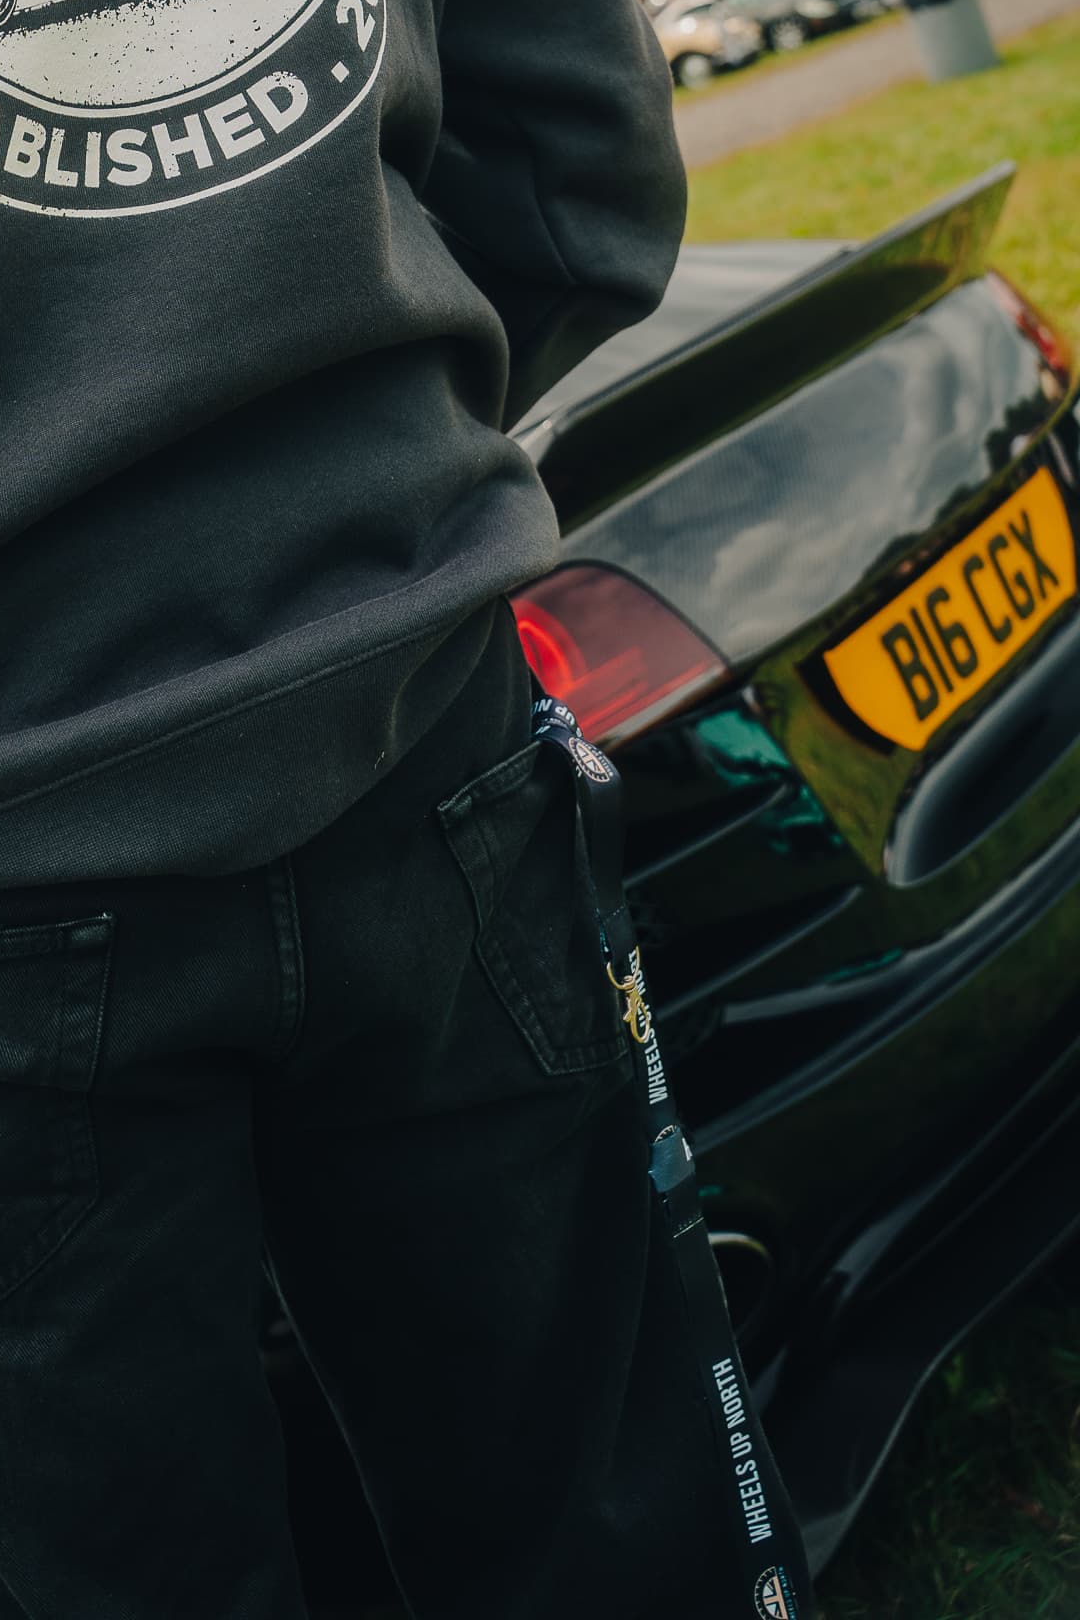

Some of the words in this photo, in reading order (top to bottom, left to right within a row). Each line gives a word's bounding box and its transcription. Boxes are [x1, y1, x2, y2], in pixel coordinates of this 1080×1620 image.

[881, 587, 979, 722] B16
[962, 508, 1059, 645] CGX
[712, 1357, 746, 1429] NORTH
[730, 1431, 753, 1459] UP
[735, 1459, 773, 1544] WHEELS
